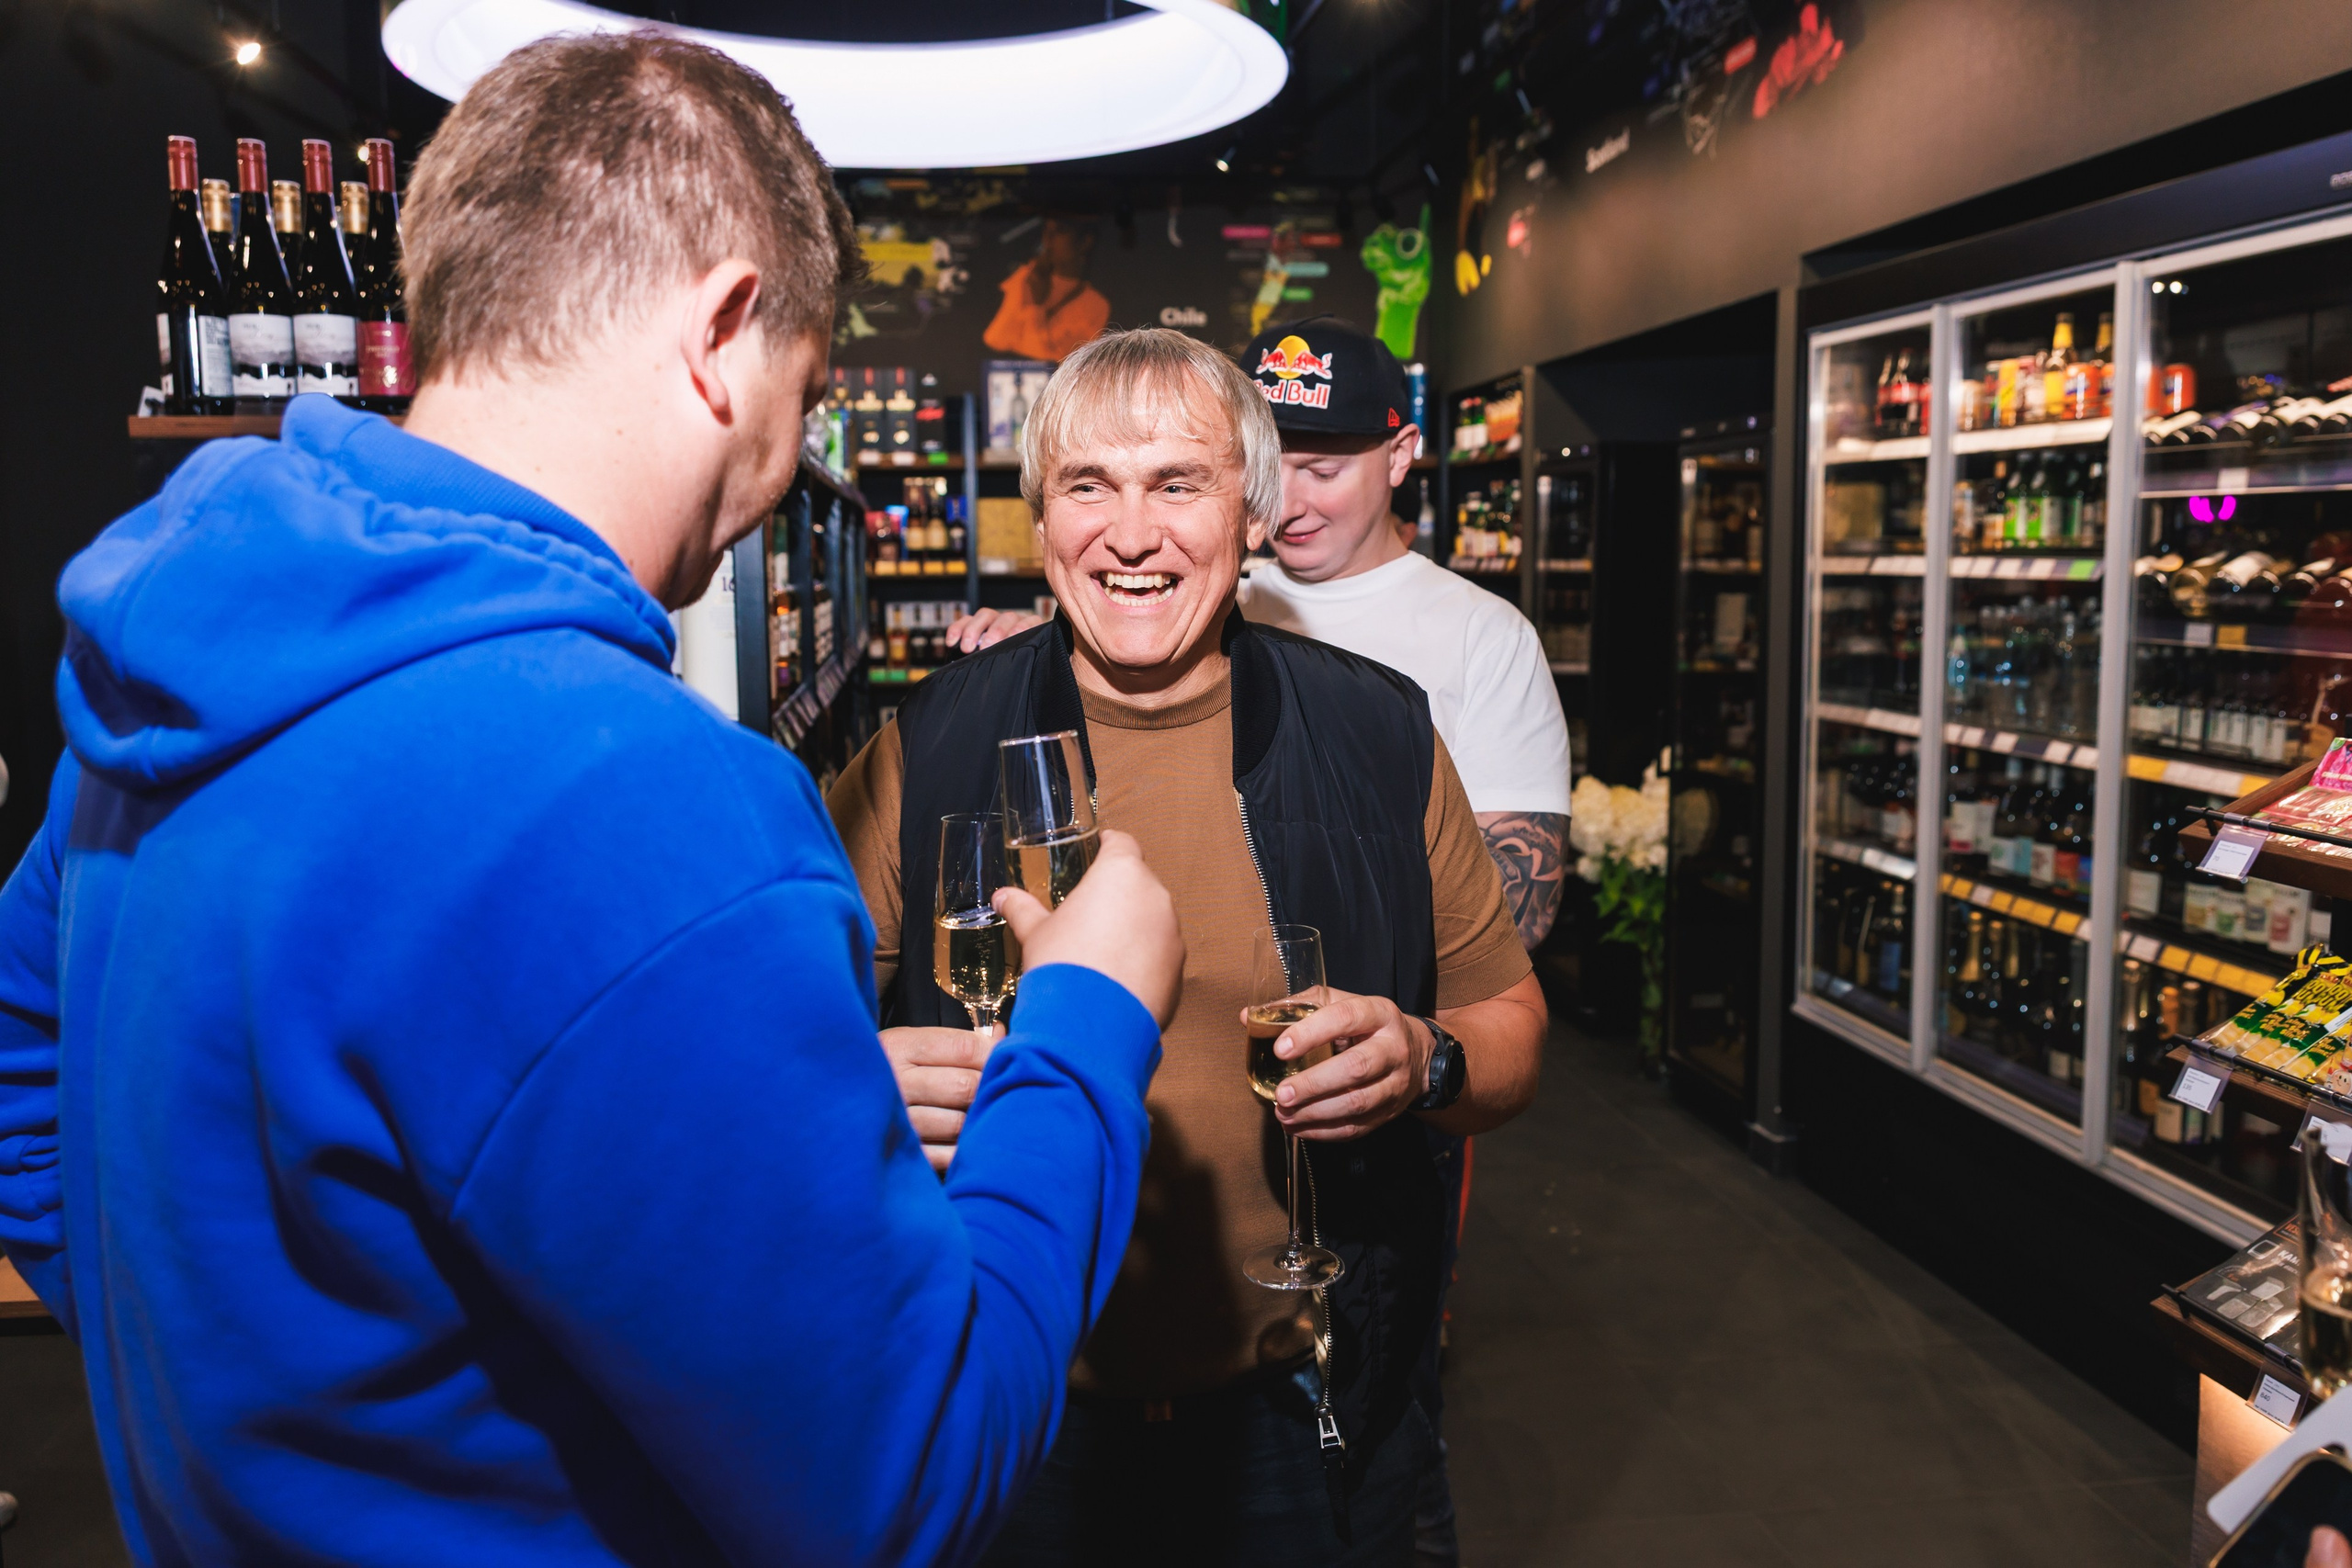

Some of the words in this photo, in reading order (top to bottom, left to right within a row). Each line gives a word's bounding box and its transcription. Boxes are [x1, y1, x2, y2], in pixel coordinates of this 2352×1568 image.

[1159, 307, 1207, 326] Chile
[1256, 379, 1286, 402] ed
[1286, 380, 1330, 409] Bull
